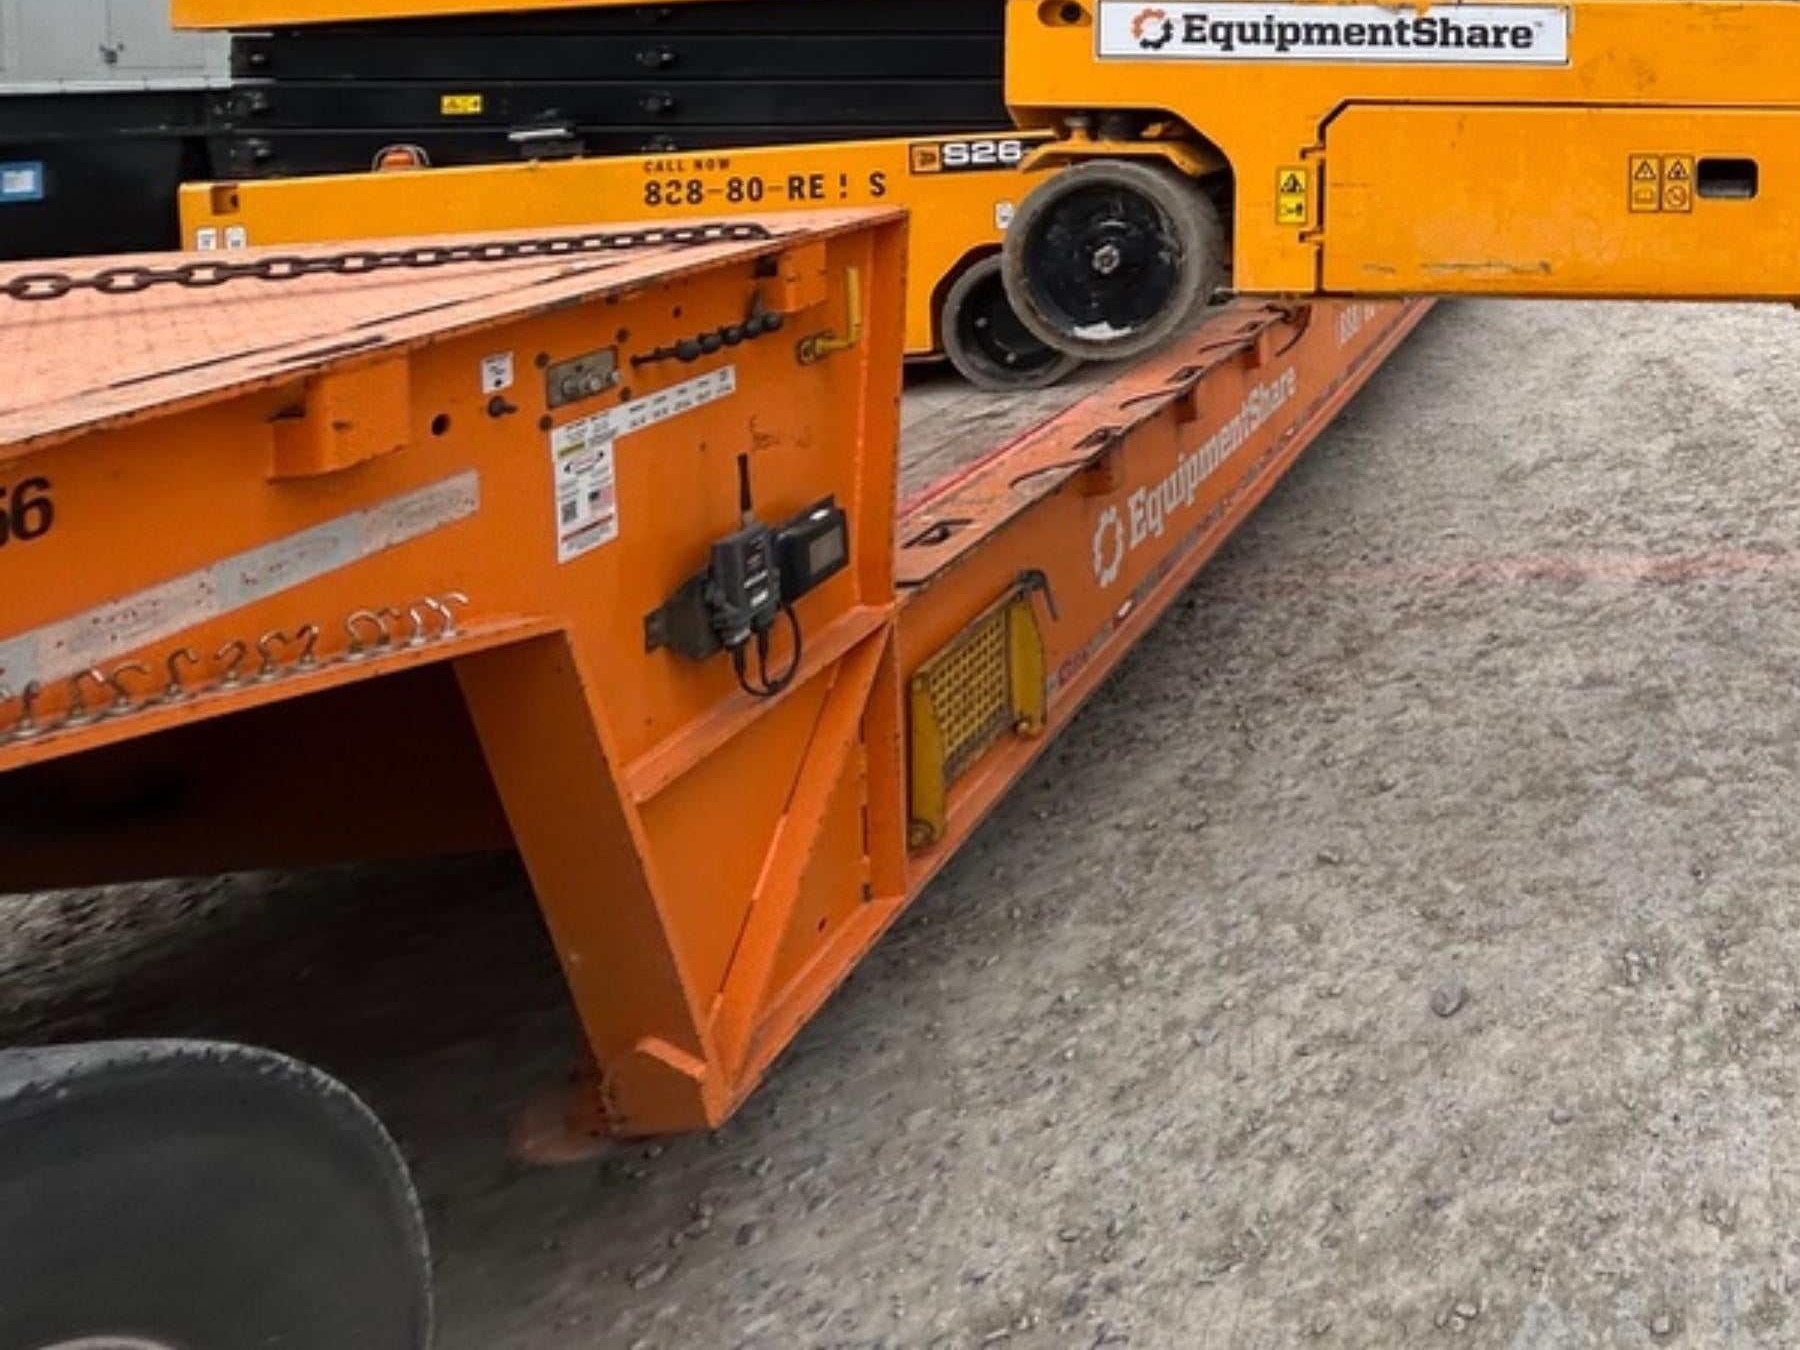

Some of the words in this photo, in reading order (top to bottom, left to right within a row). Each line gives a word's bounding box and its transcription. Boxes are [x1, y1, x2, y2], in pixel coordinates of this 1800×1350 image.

[644, 160, 686, 173] CALL
[694, 158, 730, 171] NOW
[1126, 366, 1298, 550] EquipmentShare
